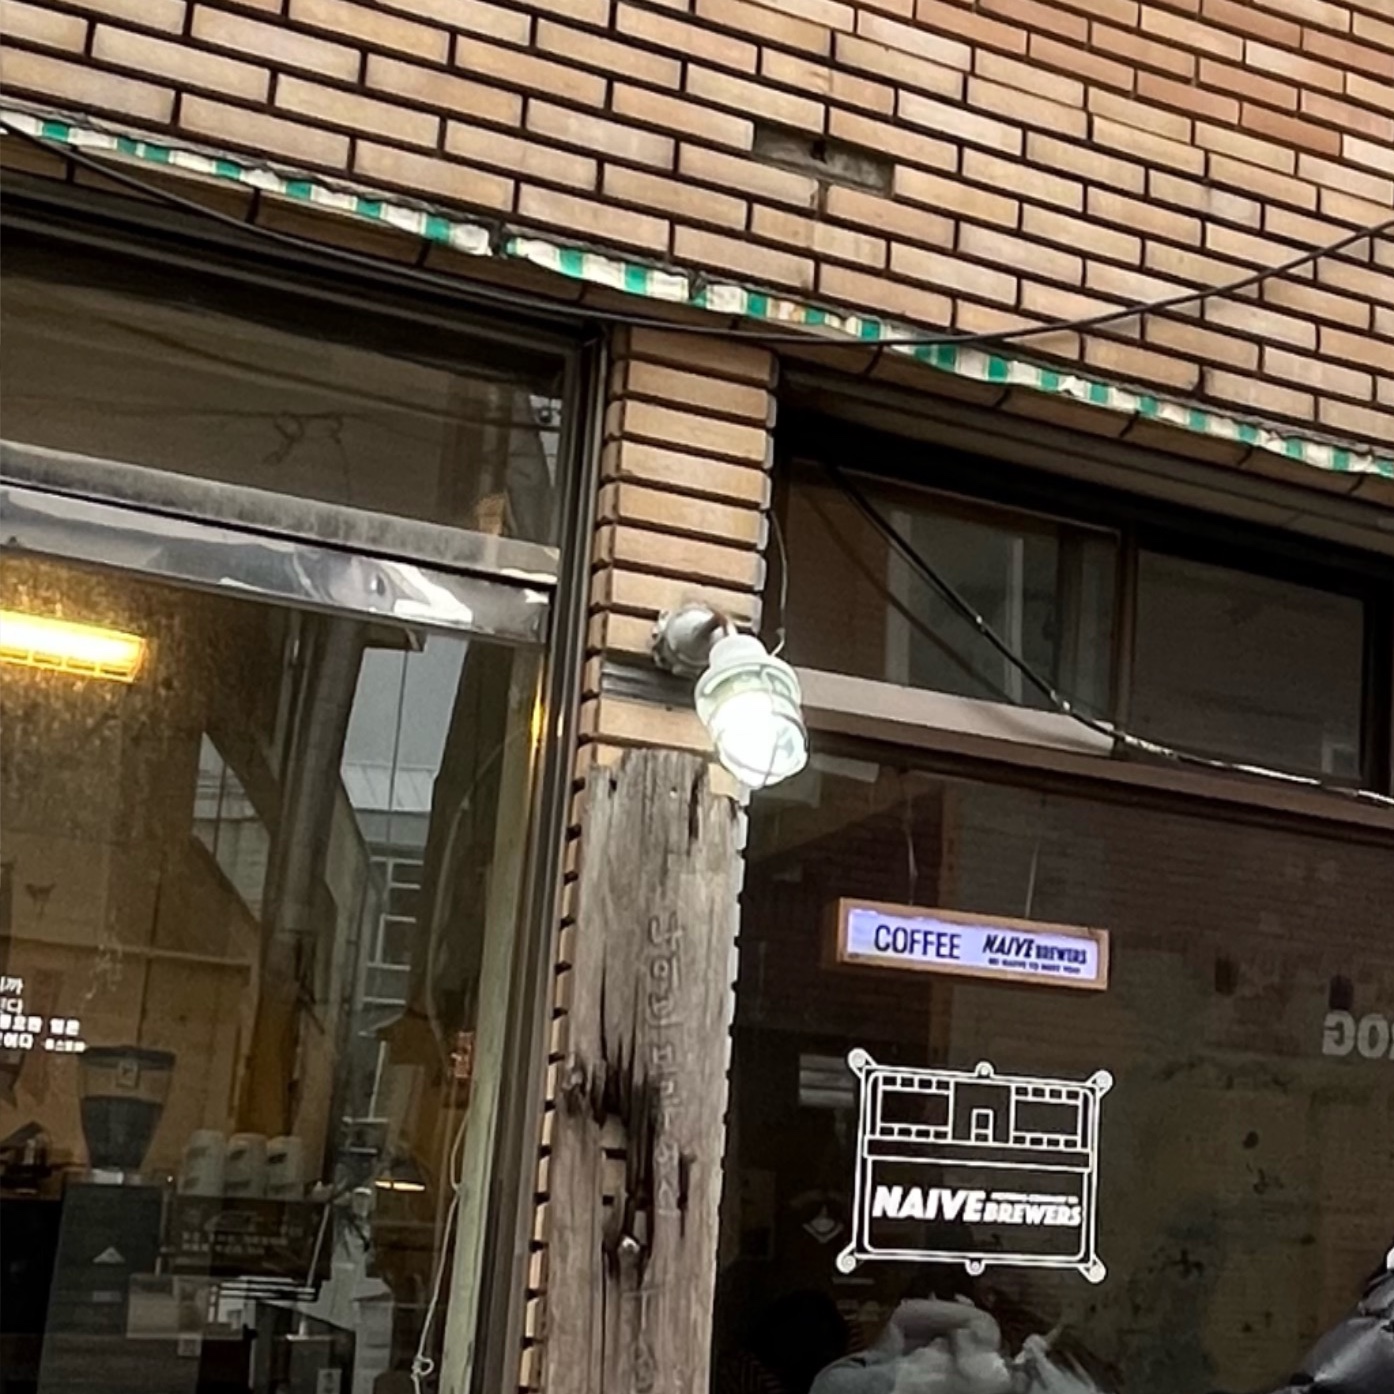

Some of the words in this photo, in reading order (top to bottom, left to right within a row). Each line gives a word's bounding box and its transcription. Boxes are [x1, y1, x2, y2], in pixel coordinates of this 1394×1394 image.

[874, 924, 962, 960] COFFEE
[982, 933, 1035, 959] NAIVE
[872, 1185, 986, 1222] NAIVE
[983, 1202, 1082, 1227] BREWERS
